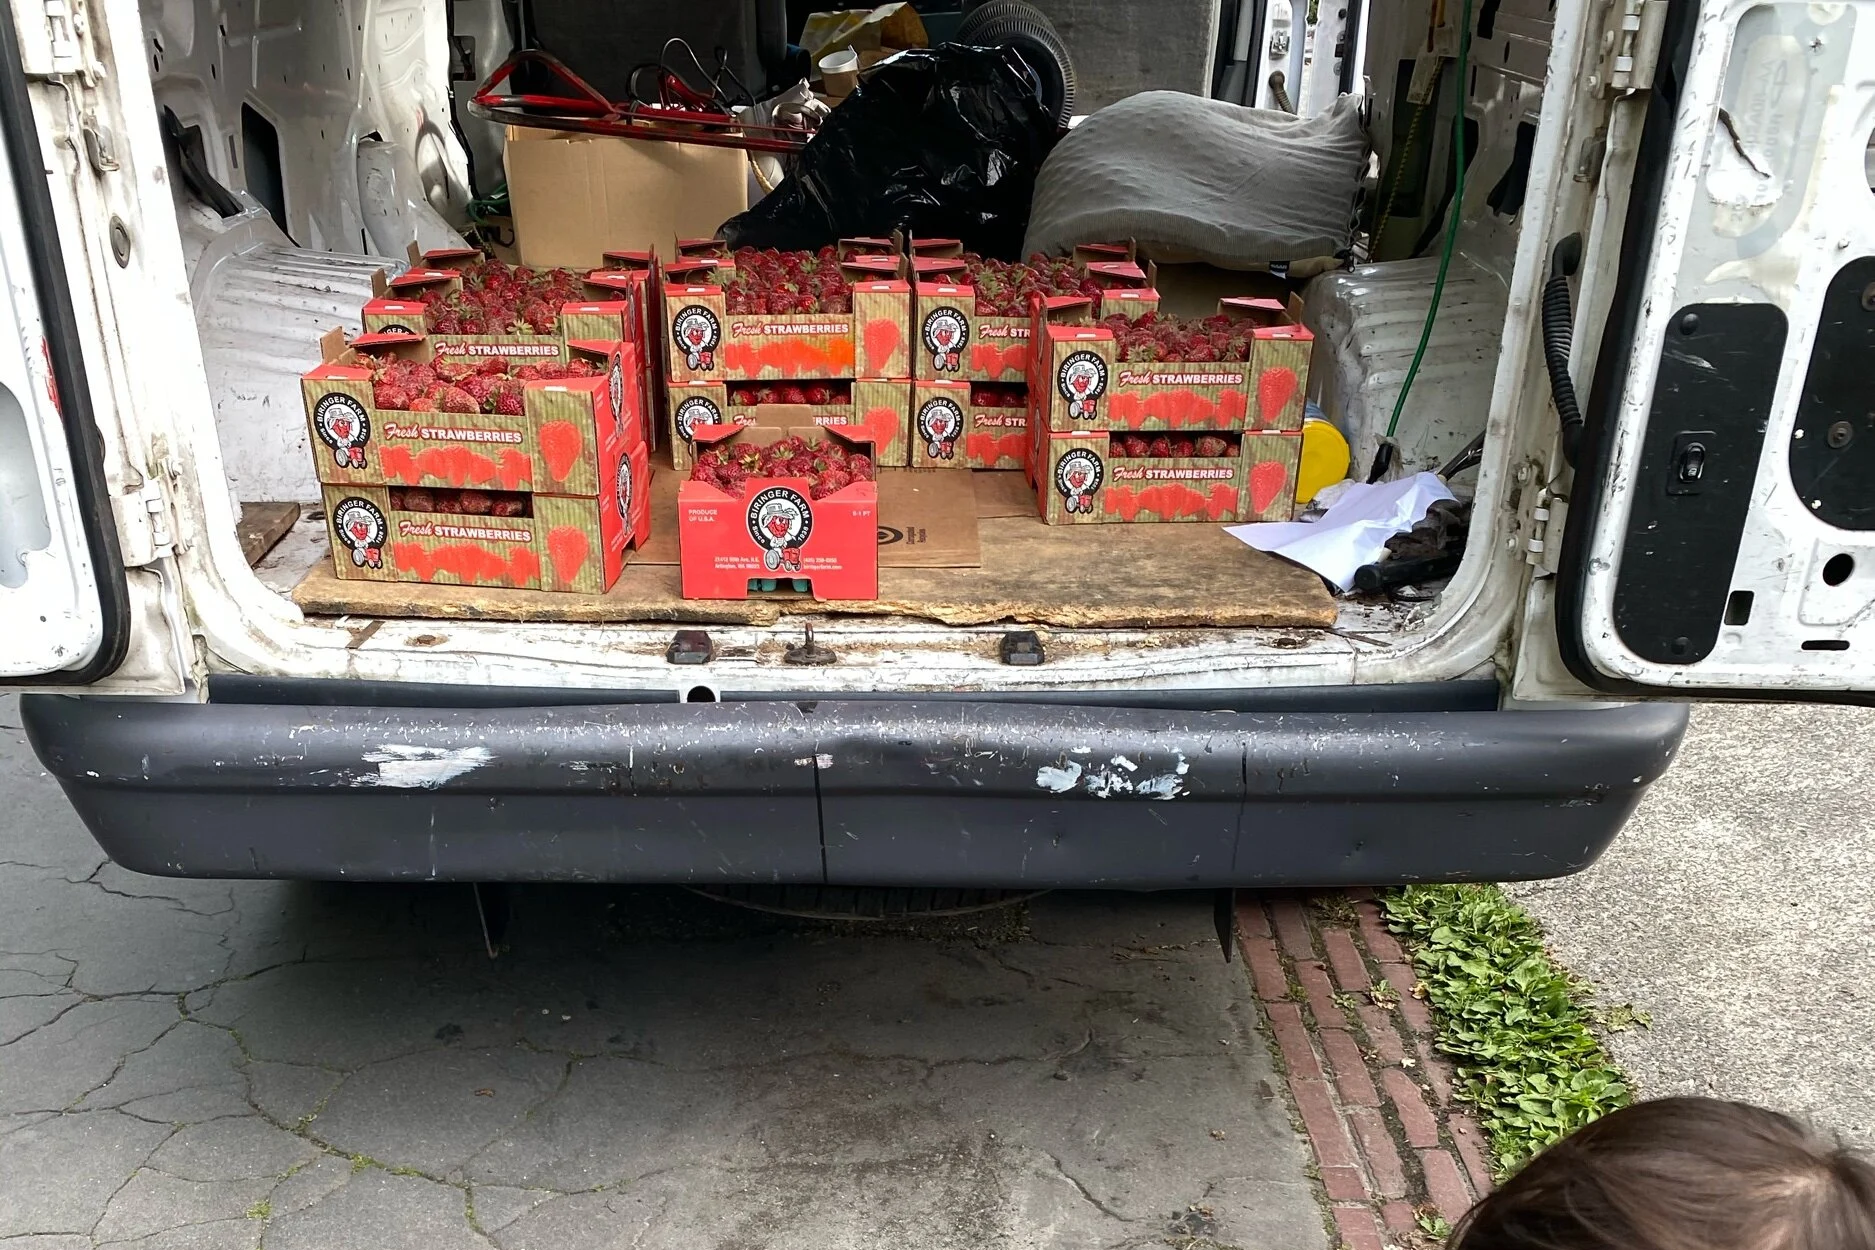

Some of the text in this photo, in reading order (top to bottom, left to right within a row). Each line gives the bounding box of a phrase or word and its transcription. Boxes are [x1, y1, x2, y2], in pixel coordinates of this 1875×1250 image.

[675, 308, 718, 331] BIRINGER FARM
[732, 322, 848, 338] Fresh STRAWBERRIES
[925, 310, 967, 332] BIRINGER FARM
[979, 324, 1008, 338] Fresh
[435, 341, 558, 356] Fresh STRAWBERRIES
[1060, 354, 1106, 377] BIRINGER FARM
[1120, 371, 1242, 386] Fresh STRAWBERRIES
[317, 396, 366, 423] BIRINGER FARM
[677, 398, 719, 421] BIRINGER FARM
[734, 415, 756, 425] Fres
[920, 400, 961, 421] BIRINGER FARM
[975, 414, 1004, 428] Fresh
[384, 423, 522, 443] Fresh STRAWBERRIES
[1058, 450, 1101, 474] BIRINGER FARM
[1113, 466, 1234, 482] Fresh STRAWBERRIES
[336, 500, 384, 525] BIRINGER FARM
[750, 490, 810, 519] BIRINGER FARM
[399, 520, 531, 542] Fresh STRAWBERRIES
